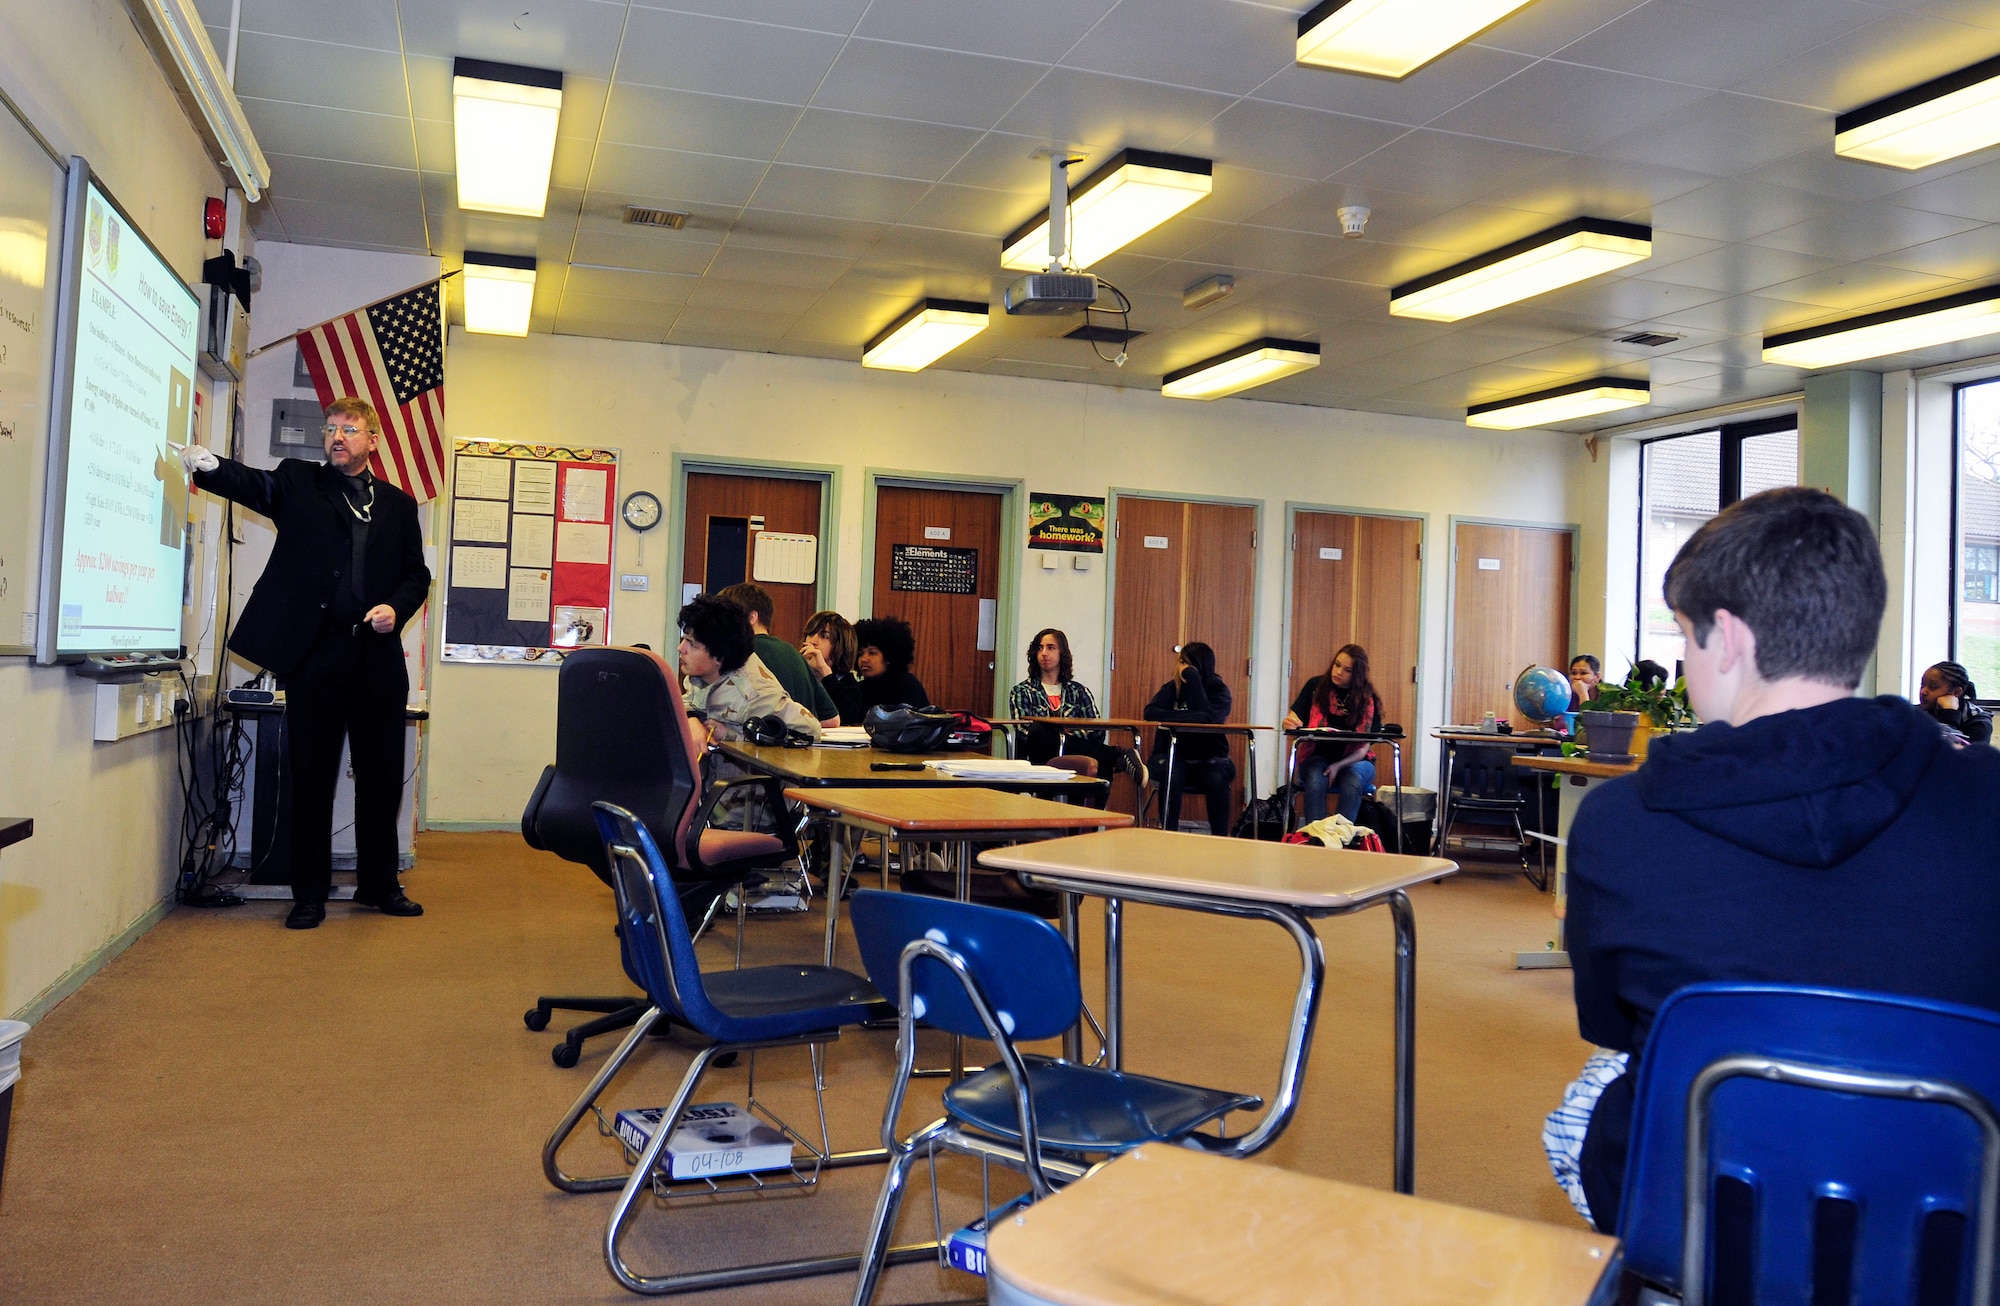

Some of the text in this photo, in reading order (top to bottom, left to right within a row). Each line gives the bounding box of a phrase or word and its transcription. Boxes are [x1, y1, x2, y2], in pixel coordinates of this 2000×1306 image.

[139, 272, 151, 299] How
[152, 287, 158, 307] to
[159, 296, 171, 319] save
[171, 304, 187, 339] Energy
[1040, 530, 1096, 542] homework?
[1049, 525, 1068, 533] There
[910, 548, 948, 558] Elements
[75, 548, 98, 573] Approx.
[112, 555, 129, 578] savings
[129, 564, 137, 580] per
[137, 566, 148, 581] year
[147, 568, 155, 583] per
[620, 1120, 645, 1152] BIOLOGY
[692, 1152, 744, 1173] 04-108
